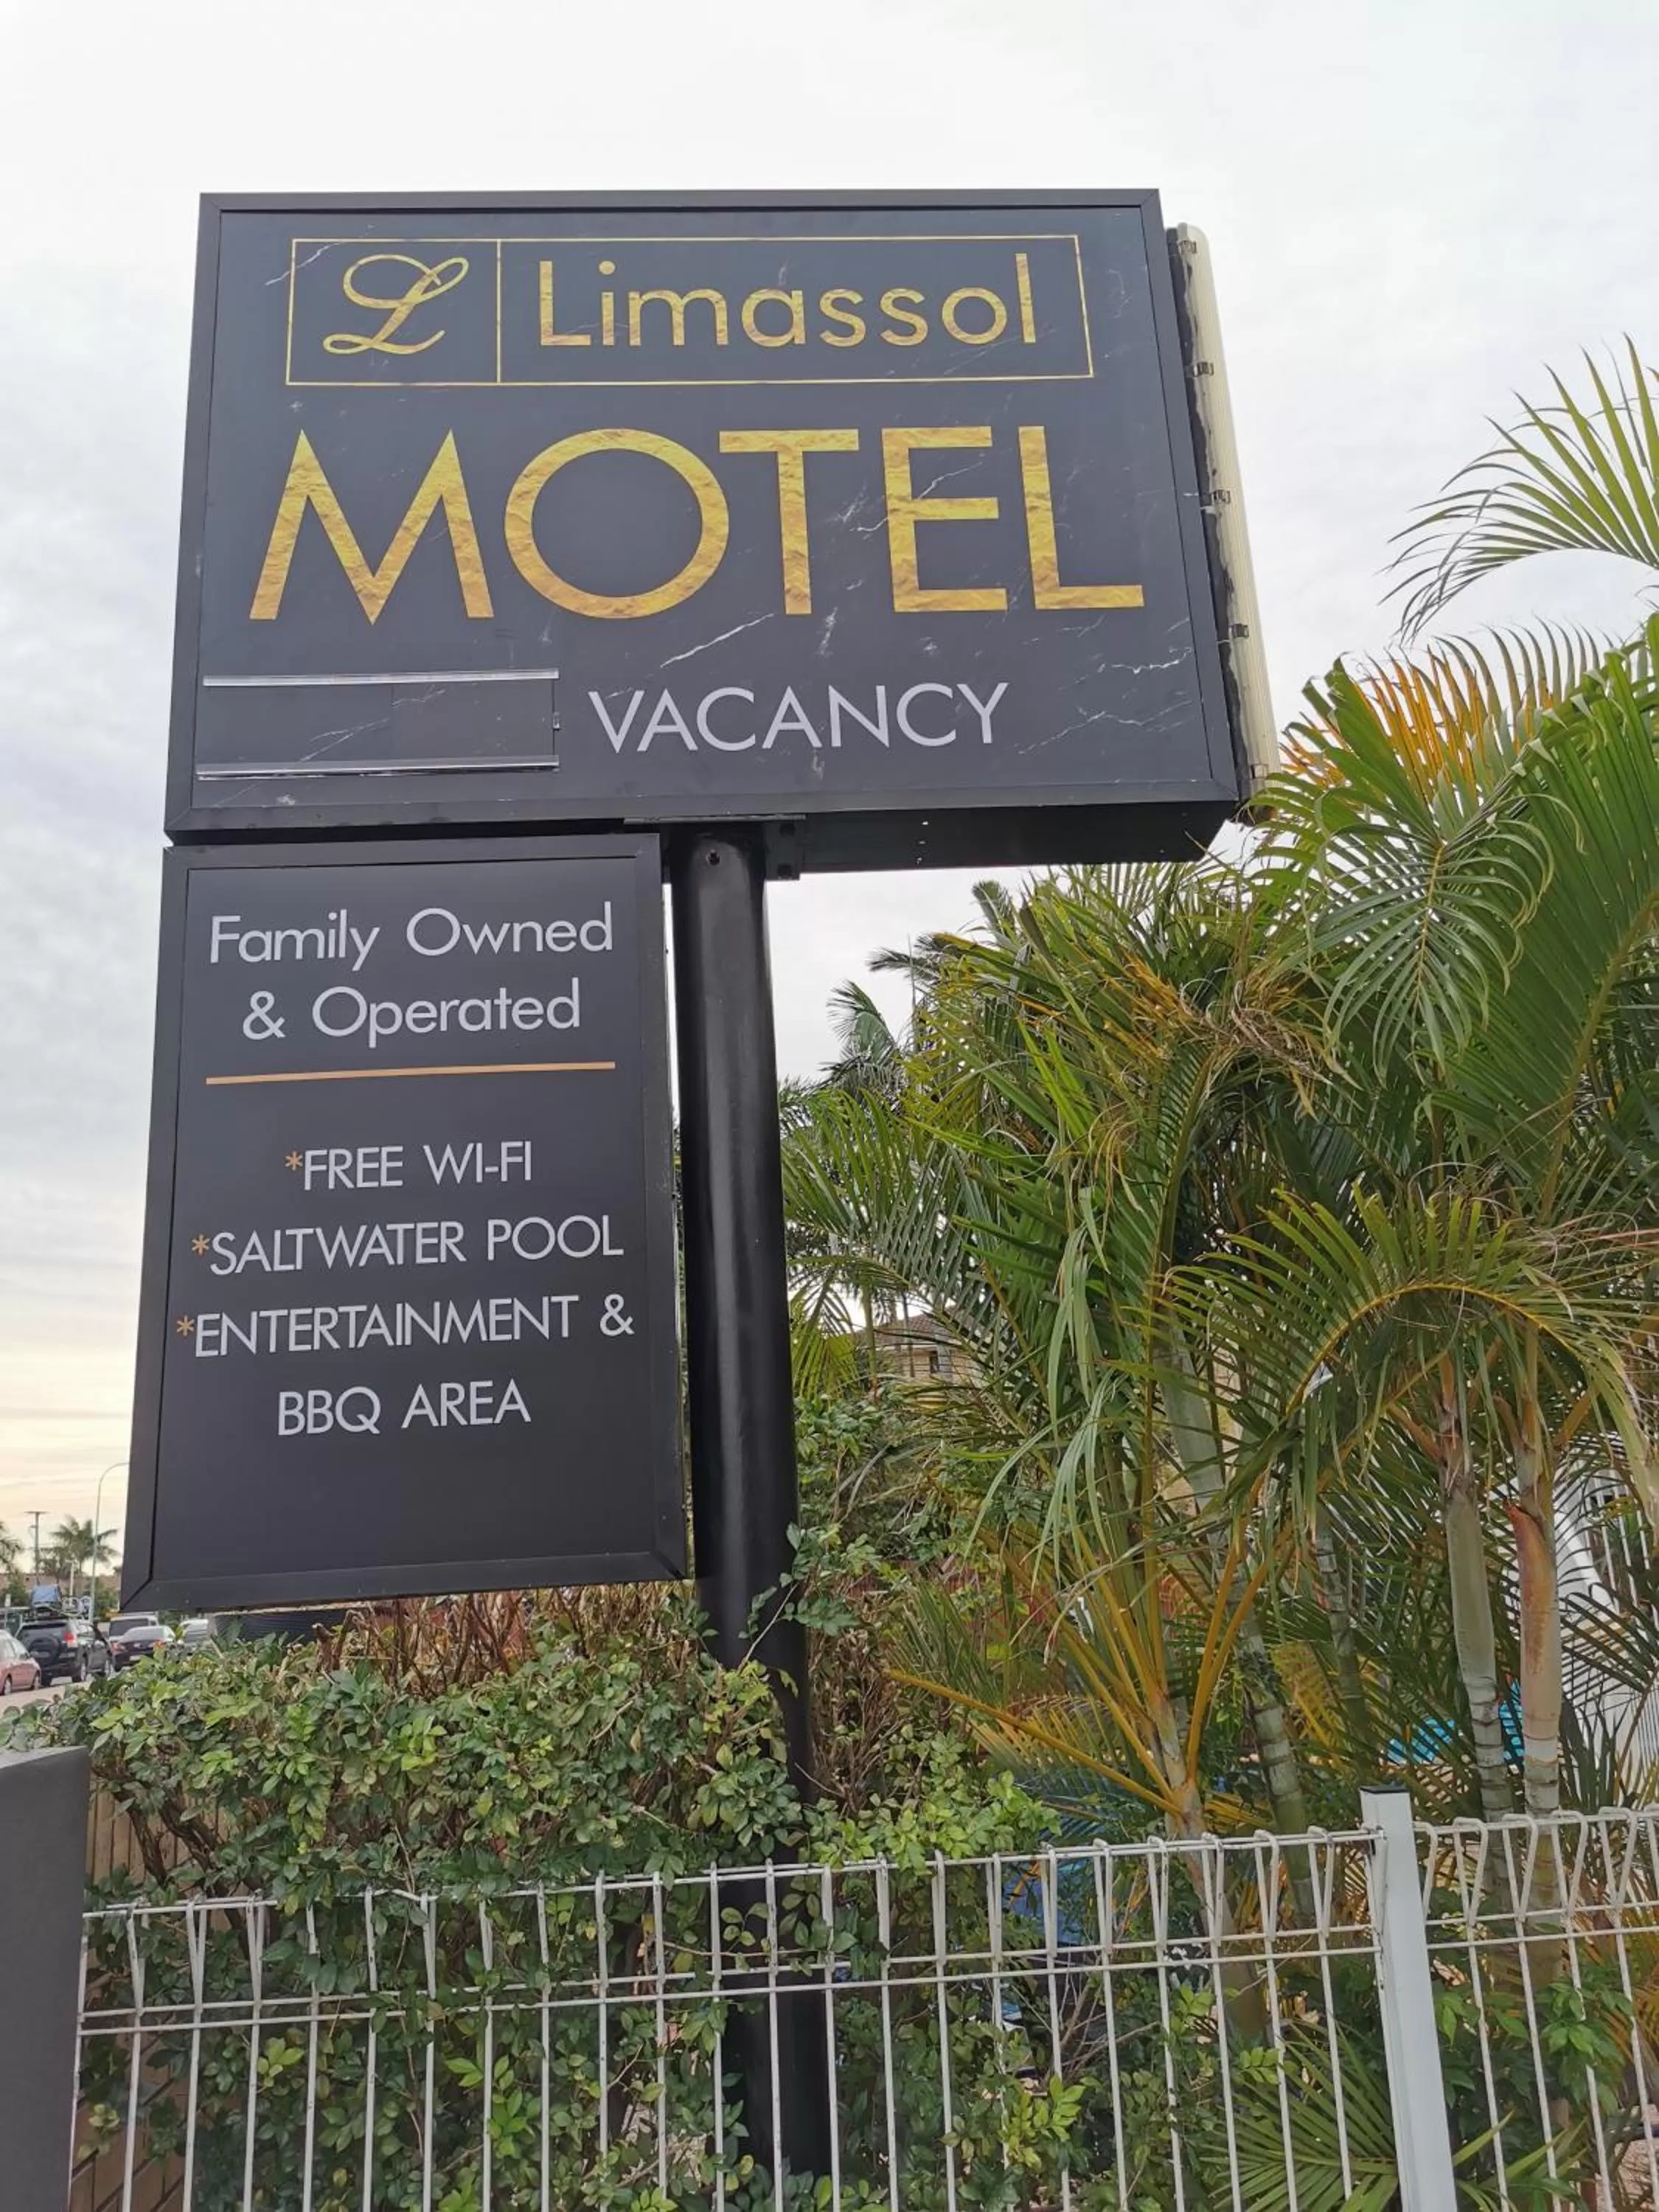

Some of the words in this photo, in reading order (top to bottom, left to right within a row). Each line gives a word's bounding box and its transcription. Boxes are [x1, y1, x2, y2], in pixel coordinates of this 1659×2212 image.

[540, 254, 1035, 346] Limassol
[249, 425, 1144, 625] MOTEL
[588, 683, 1009, 753] VACANCY
[211, 909, 380, 971] Family
[407, 901, 612, 956] Owned
[243, 991, 285, 1040] &
[313, 978, 580, 1048] Operated
[423, 1141, 531, 1184] WI-FI
[488, 1215, 624, 1260] POOL
[600, 1294, 634, 1336] &
[279, 1386, 380, 1435] BBQ
[401, 1379, 531, 1428] AREA
